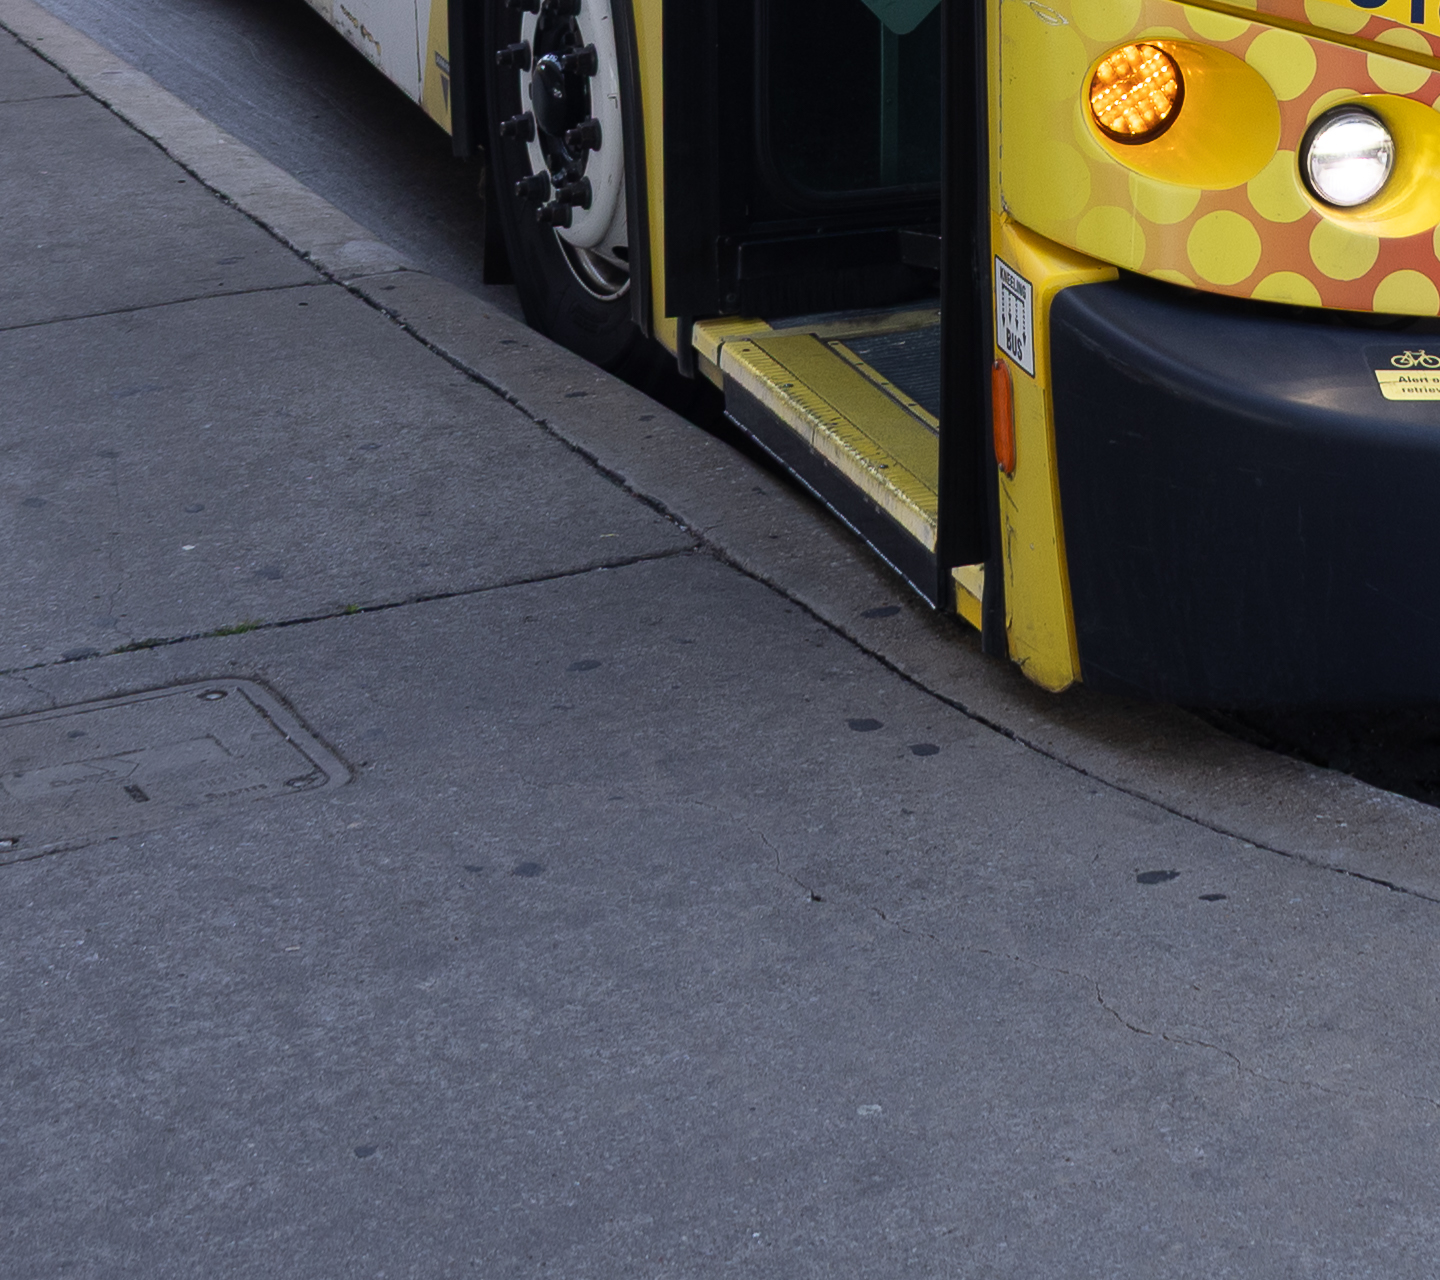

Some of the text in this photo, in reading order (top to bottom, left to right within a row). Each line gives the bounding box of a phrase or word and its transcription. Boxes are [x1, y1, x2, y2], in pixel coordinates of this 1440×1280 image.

[999, 265, 1027, 300] KNEELING
[1006, 326, 1023, 361] BUS
[1398, 375, 1429, 384] Alert
